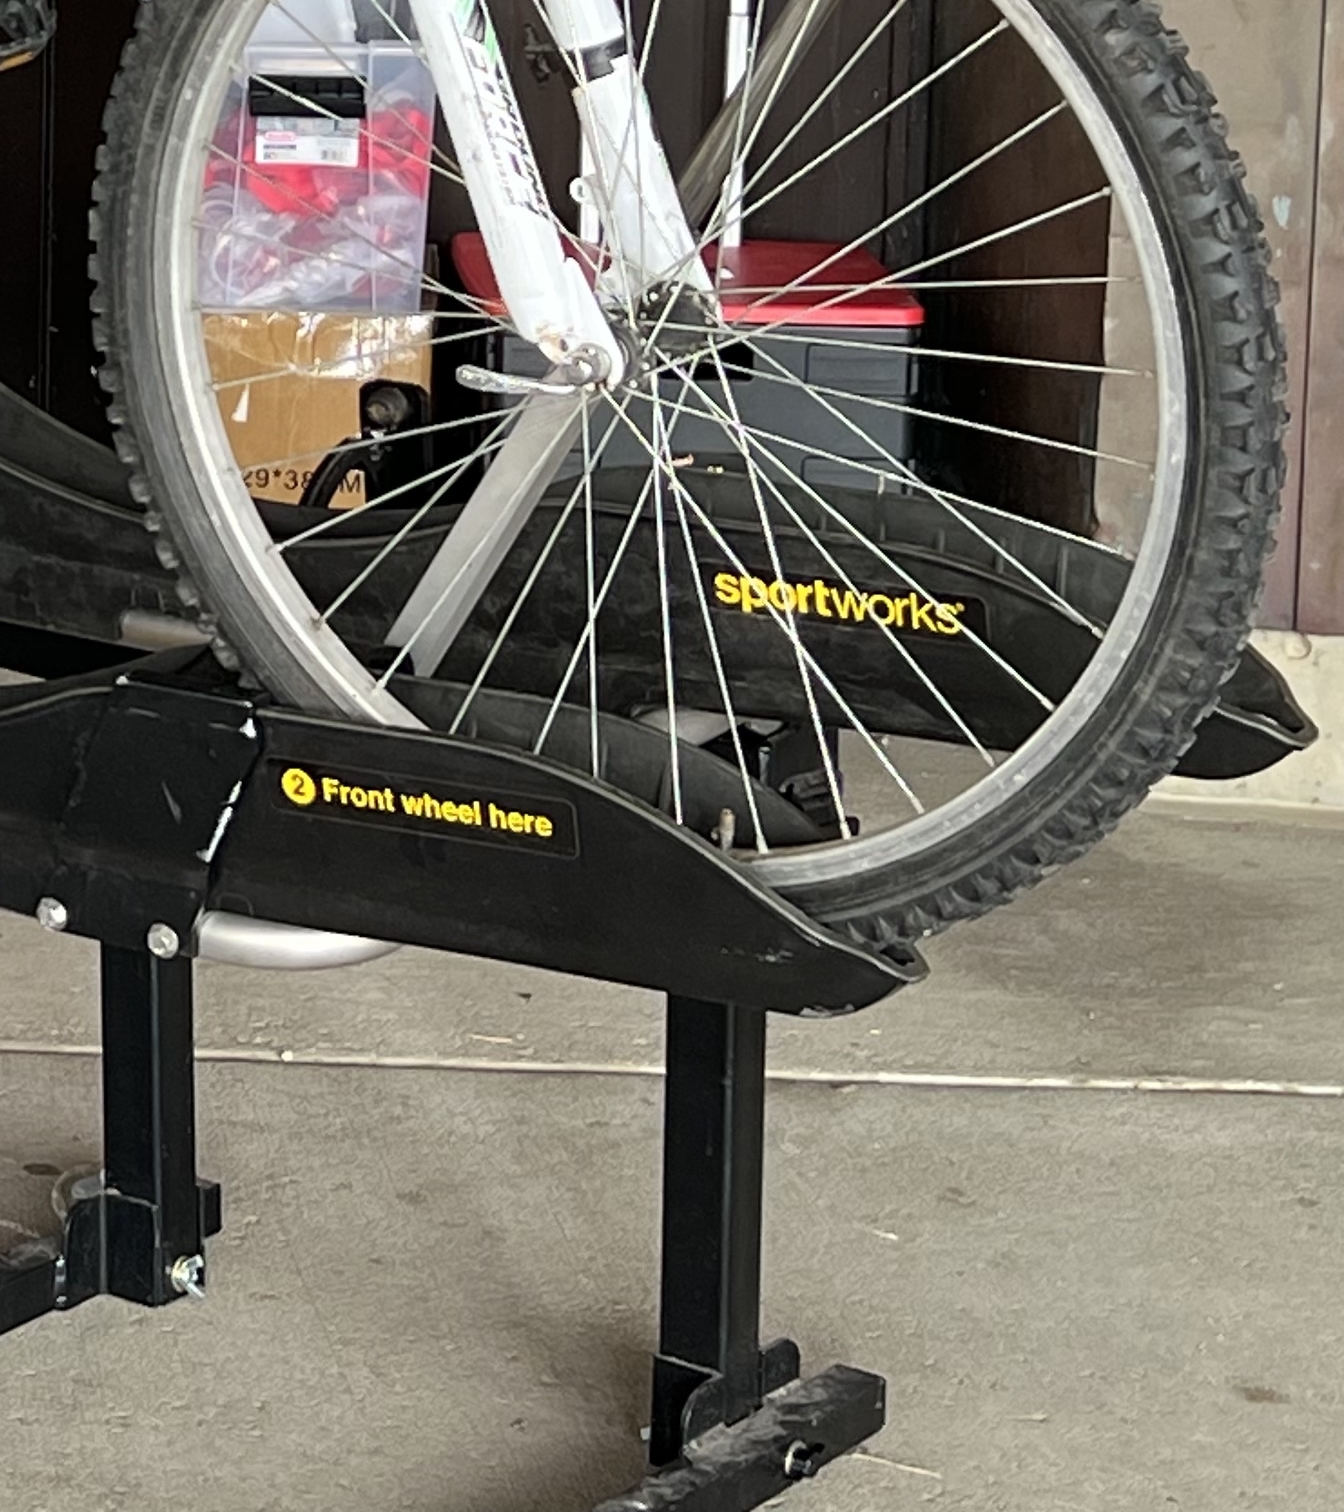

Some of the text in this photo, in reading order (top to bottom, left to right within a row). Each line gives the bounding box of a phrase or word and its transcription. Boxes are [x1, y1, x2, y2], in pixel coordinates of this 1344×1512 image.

[714, 572, 964, 634] sportworks
[321, 777, 396, 813] Front
[401, 792, 482, 826] wheel
[488, 803, 554, 837] here
